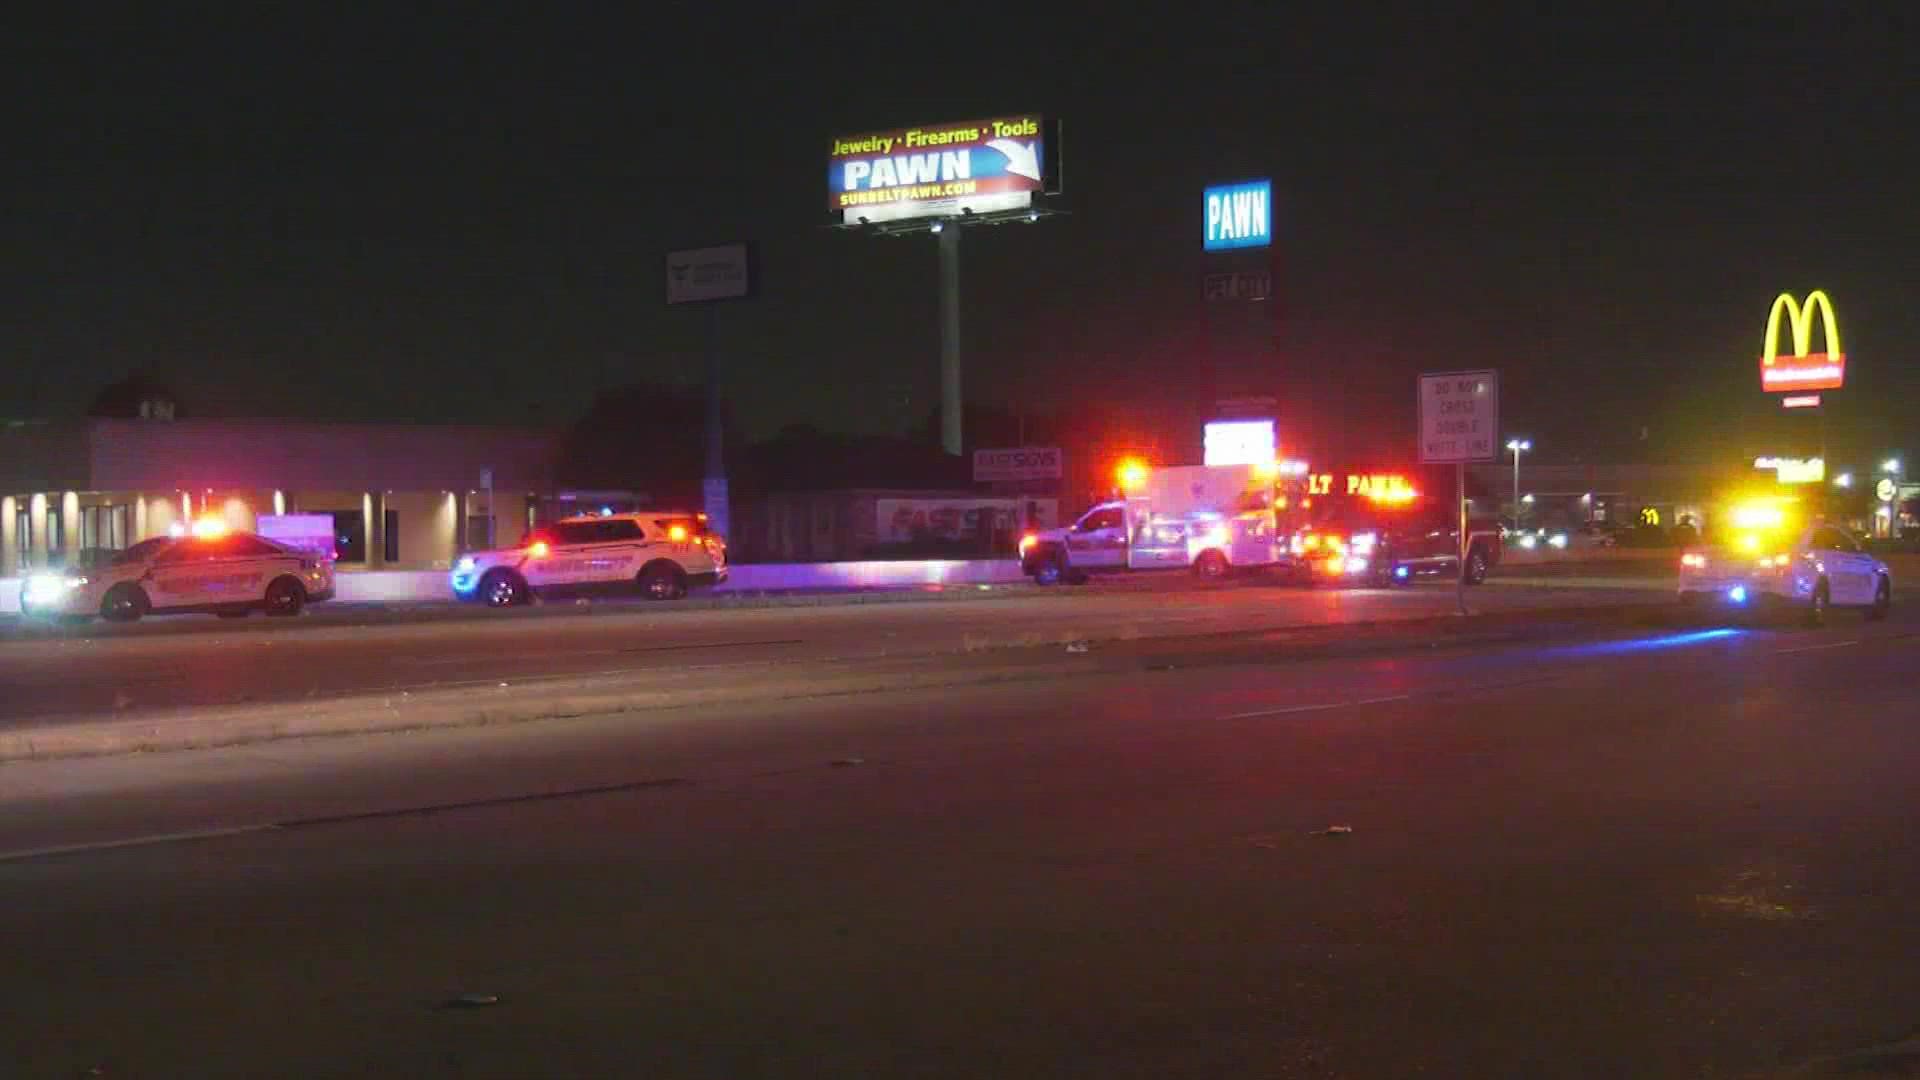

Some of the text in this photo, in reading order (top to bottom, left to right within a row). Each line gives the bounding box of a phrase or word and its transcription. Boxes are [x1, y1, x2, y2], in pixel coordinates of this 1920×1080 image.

[832, 118, 1037, 156] Jewelry Firearms Tools
[844, 150, 971, 190] PAWN
[840, 181, 977, 206] SUNBELTPAWN.COM
[1208, 190, 1265, 240] PAWN
[1433, 381, 1449, 395] DO
